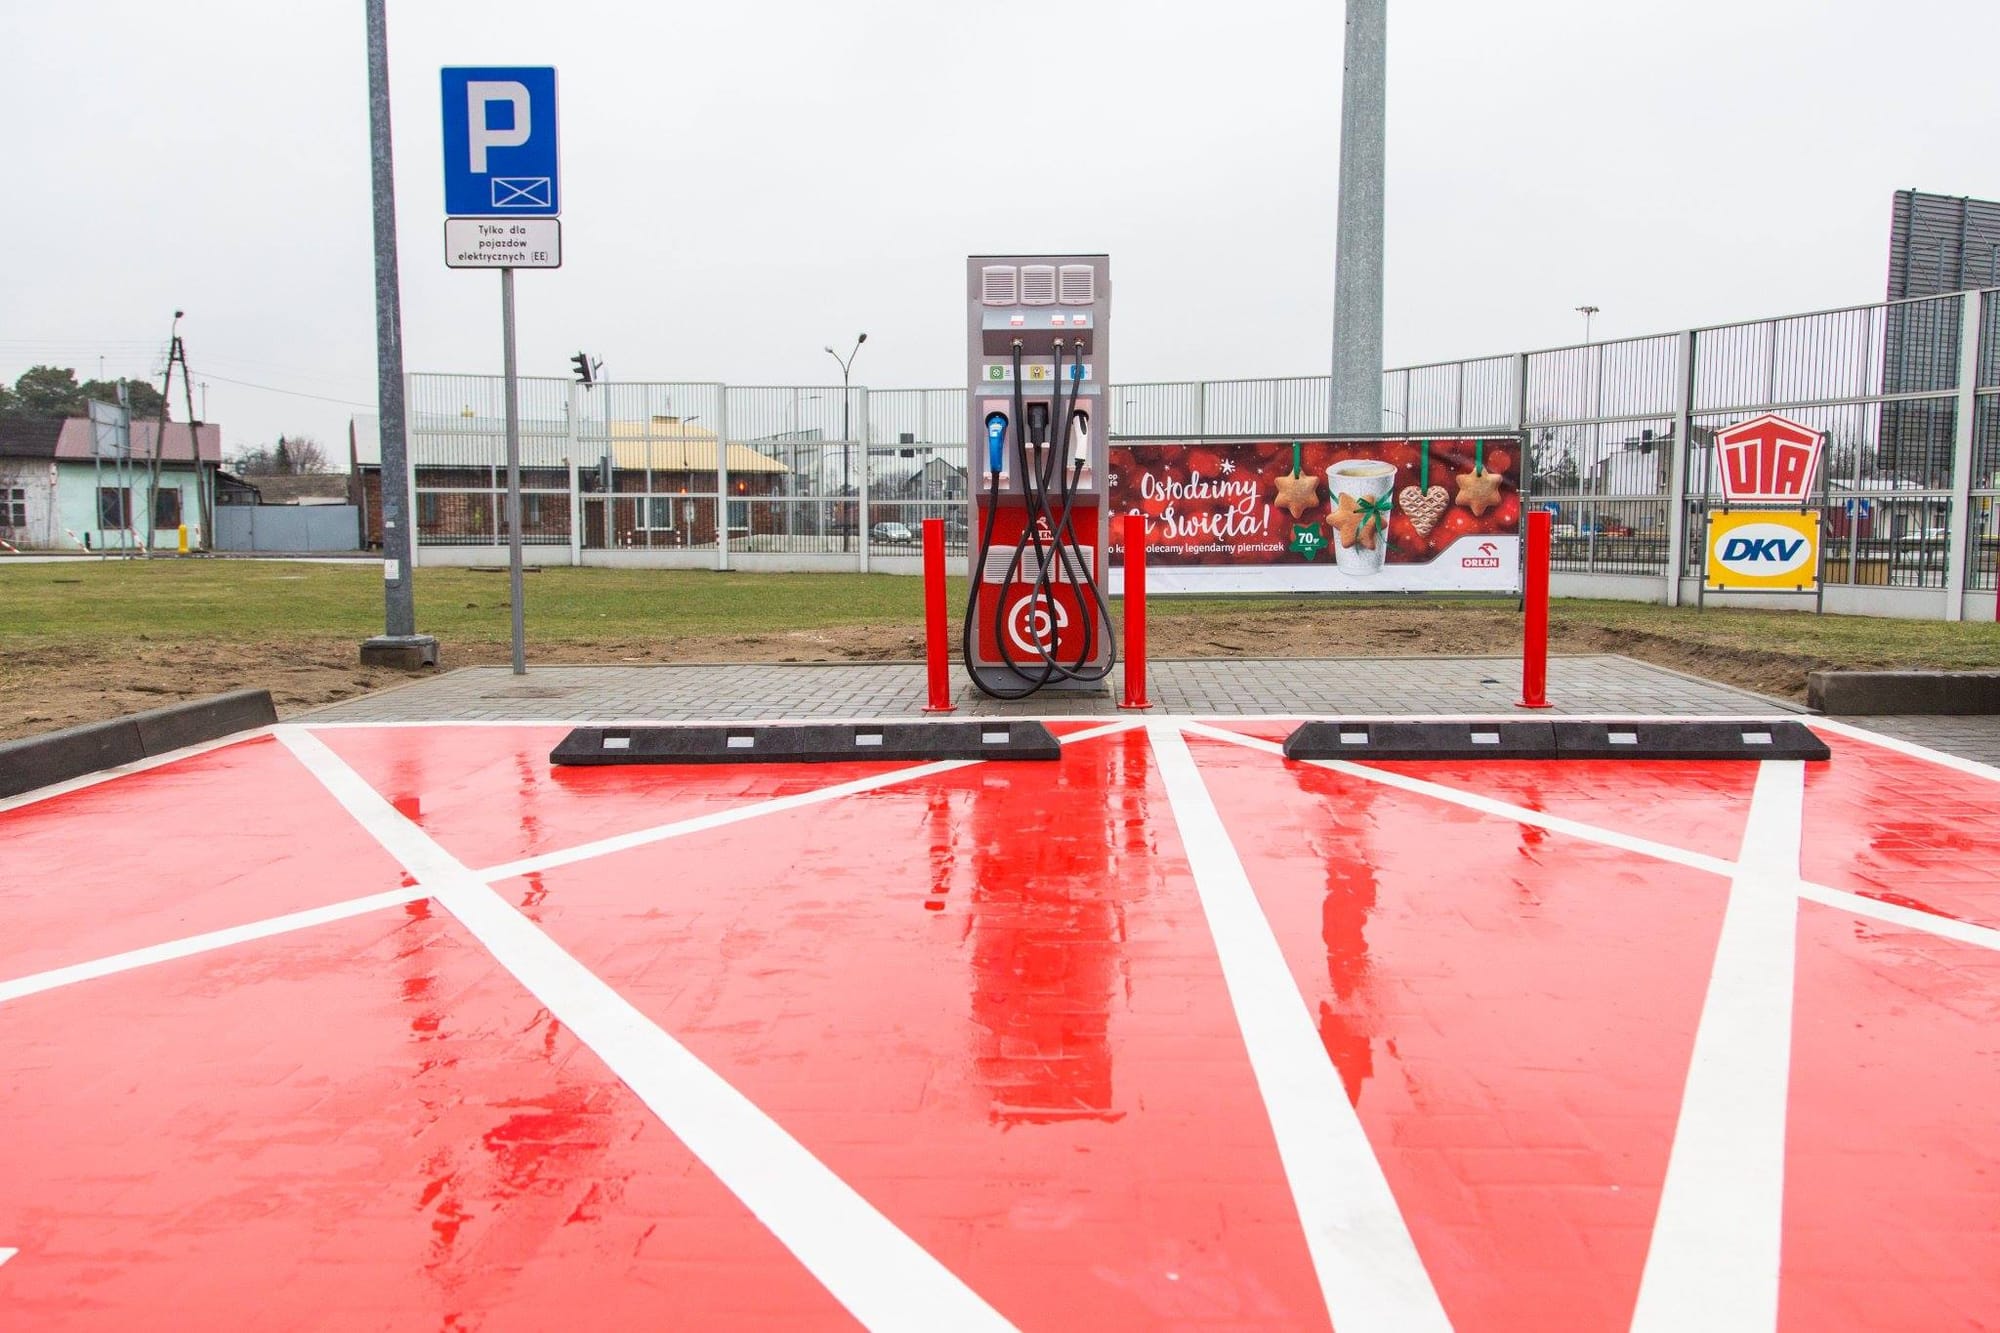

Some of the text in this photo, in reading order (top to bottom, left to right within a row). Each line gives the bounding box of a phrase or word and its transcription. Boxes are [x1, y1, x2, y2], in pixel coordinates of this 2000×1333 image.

[467, 81, 532, 174] P
[478, 225, 526, 236] Tylko dla
[458, 251, 525, 263] elektrycznych
[1724, 421, 1814, 495] UTA
[1141, 470, 1262, 515] Osłodzimy
[1160, 501, 1270, 542] Święta!
[1146, 543, 1184, 555] olecamy
[1185, 543, 1235, 555] legendarny
[1238, 541, 1285, 554] pierniczek
[1722, 538, 1805, 562] DKV
[1463, 558, 1498, 567] ORLEN
